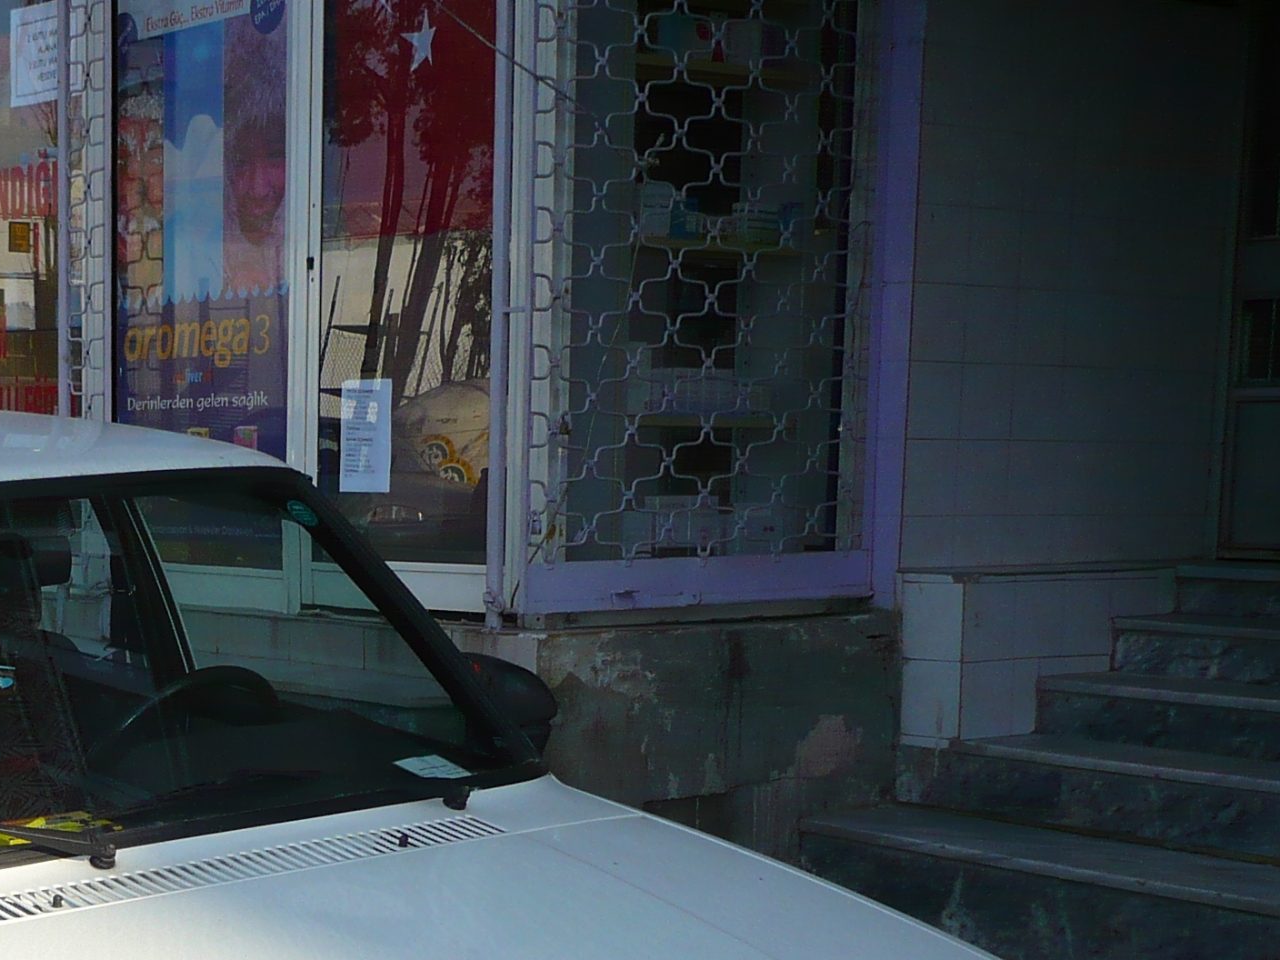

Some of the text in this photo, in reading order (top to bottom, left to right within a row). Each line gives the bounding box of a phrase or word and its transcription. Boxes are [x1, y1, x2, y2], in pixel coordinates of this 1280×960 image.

[254, 314, 272, 356] 3
[127, 390, 270, 412] Derinlerden gelen sağlık
